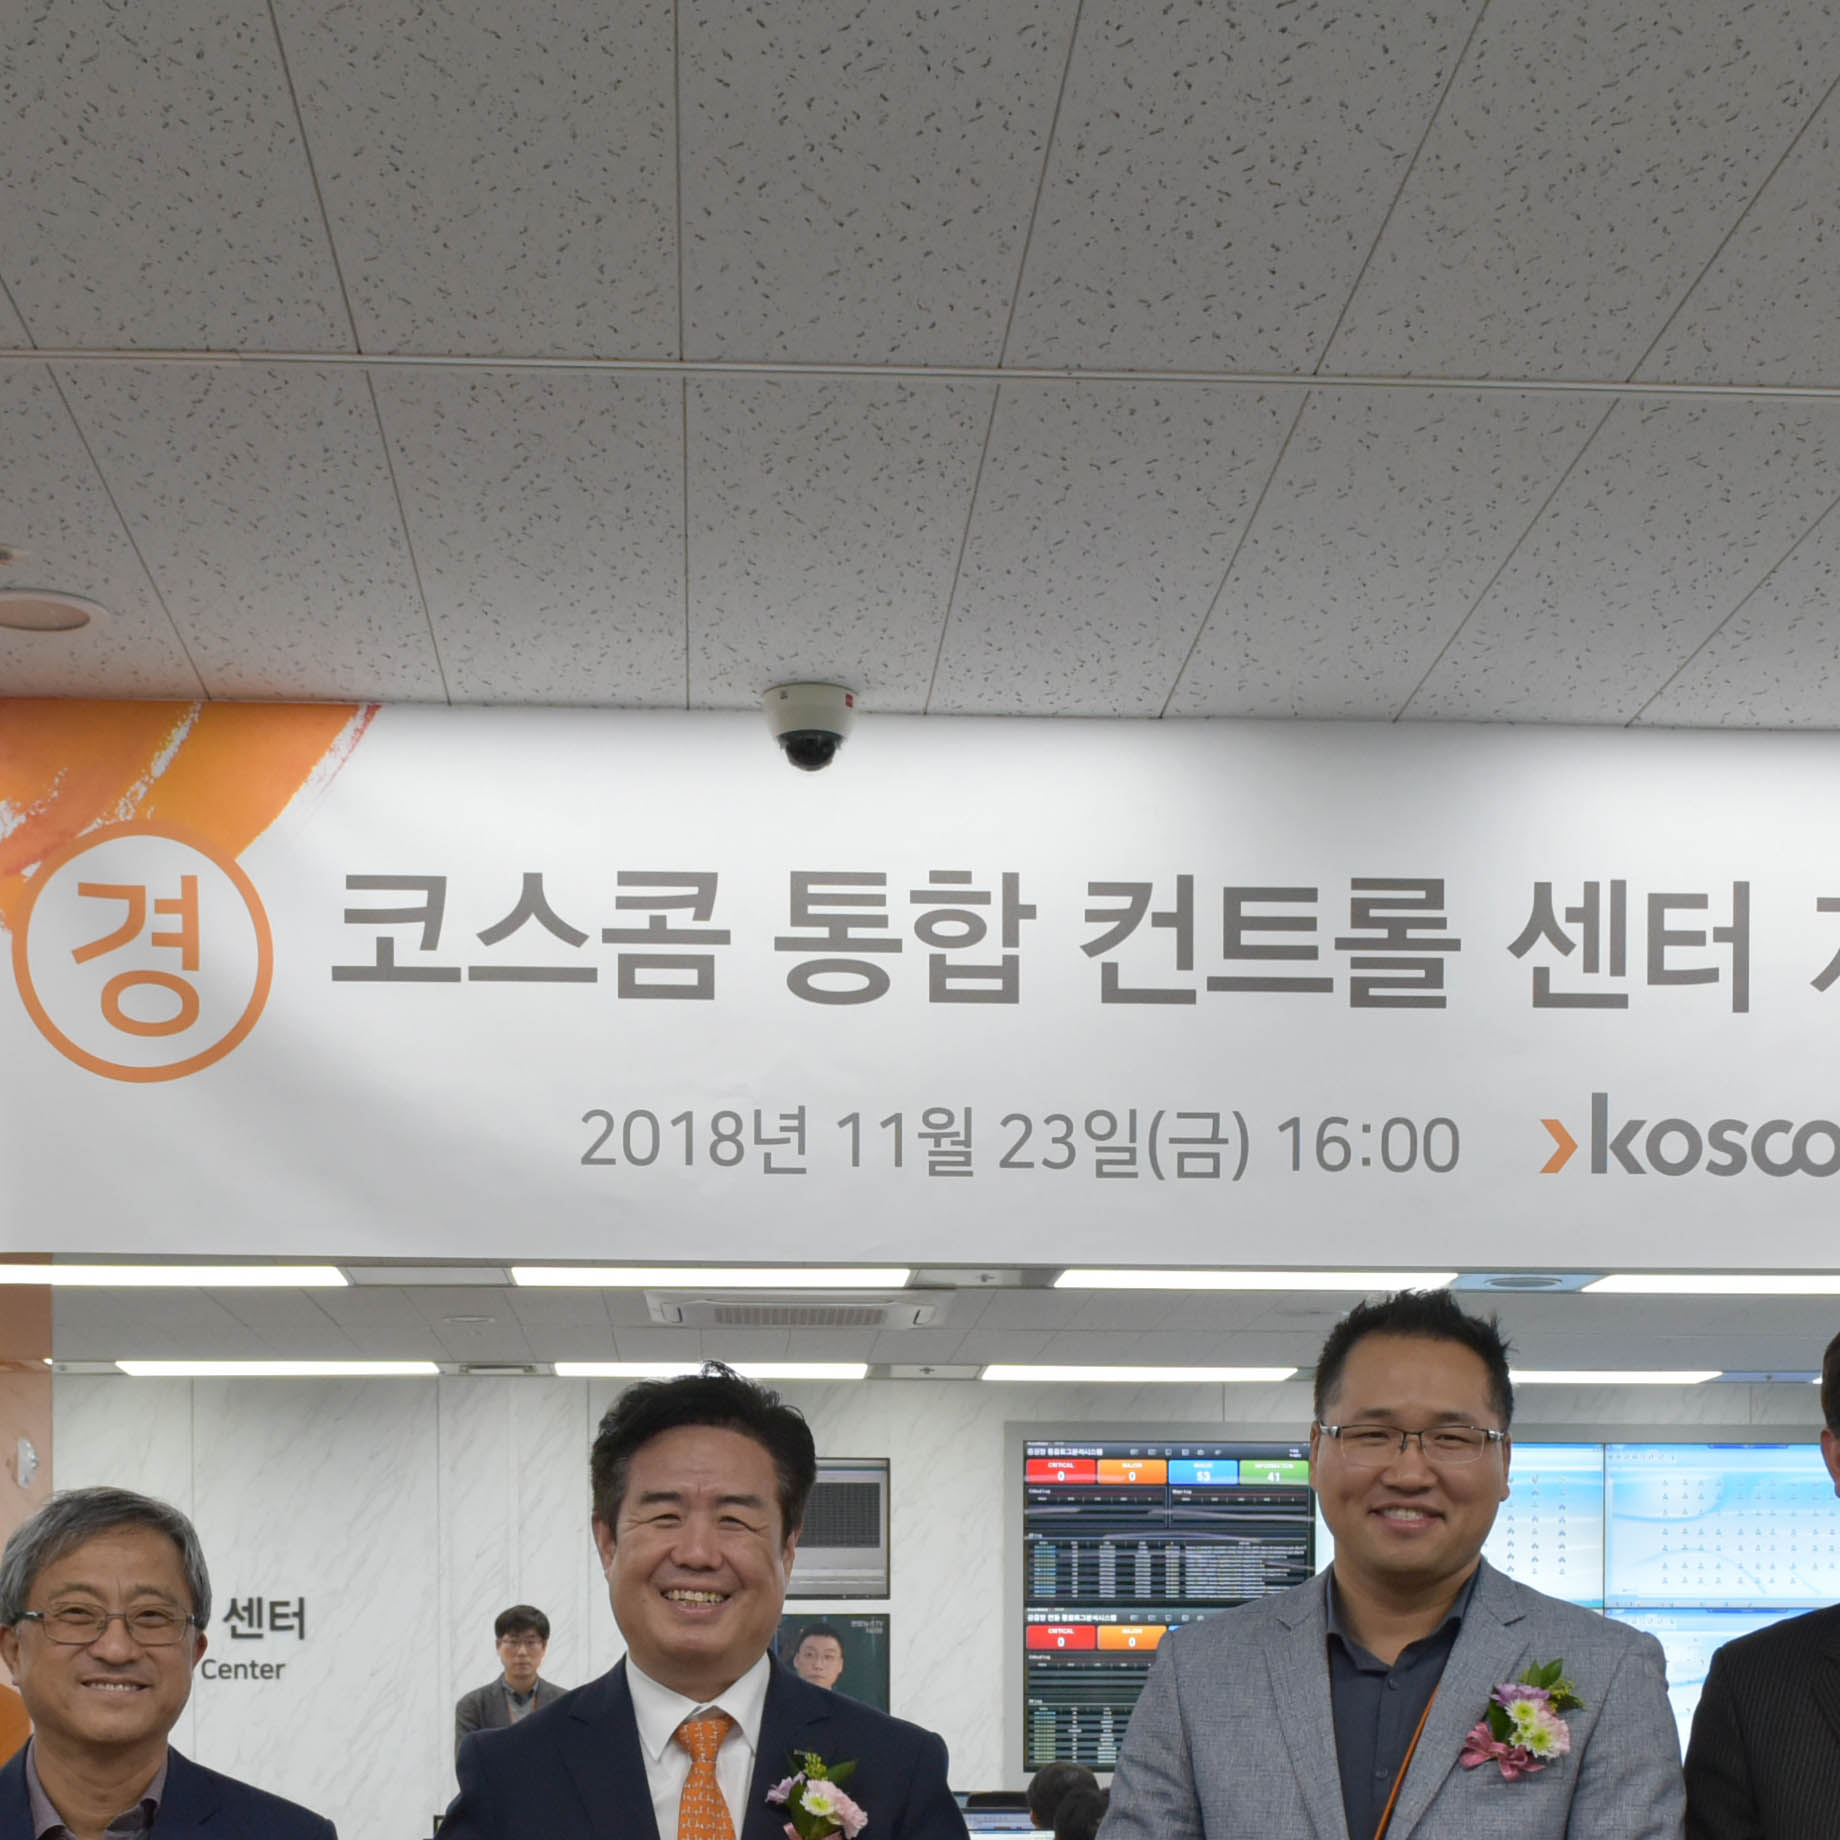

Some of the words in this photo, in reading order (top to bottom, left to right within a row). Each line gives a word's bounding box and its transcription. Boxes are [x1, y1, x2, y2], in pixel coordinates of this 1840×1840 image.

[69, 874, 202, 1038] 경
[330, 869, 732, 1002] 코스콤
[773, 869, 1038, 1007] 통합
[1080, 869, 1462, 1011] 컨트롤
[1505, 878, 1751, 1014] 센터
[580, 1104, 808, 1176] 2018년
[837, 1106, 974, 1178] 11월
[998, 1106, 1250, 1183] 23일(금)
[1277, 1115, 1461, 1175] 16:00
[222, 1596, 305, 1641] 센터
[200, 1658, 286, 1681] Center
